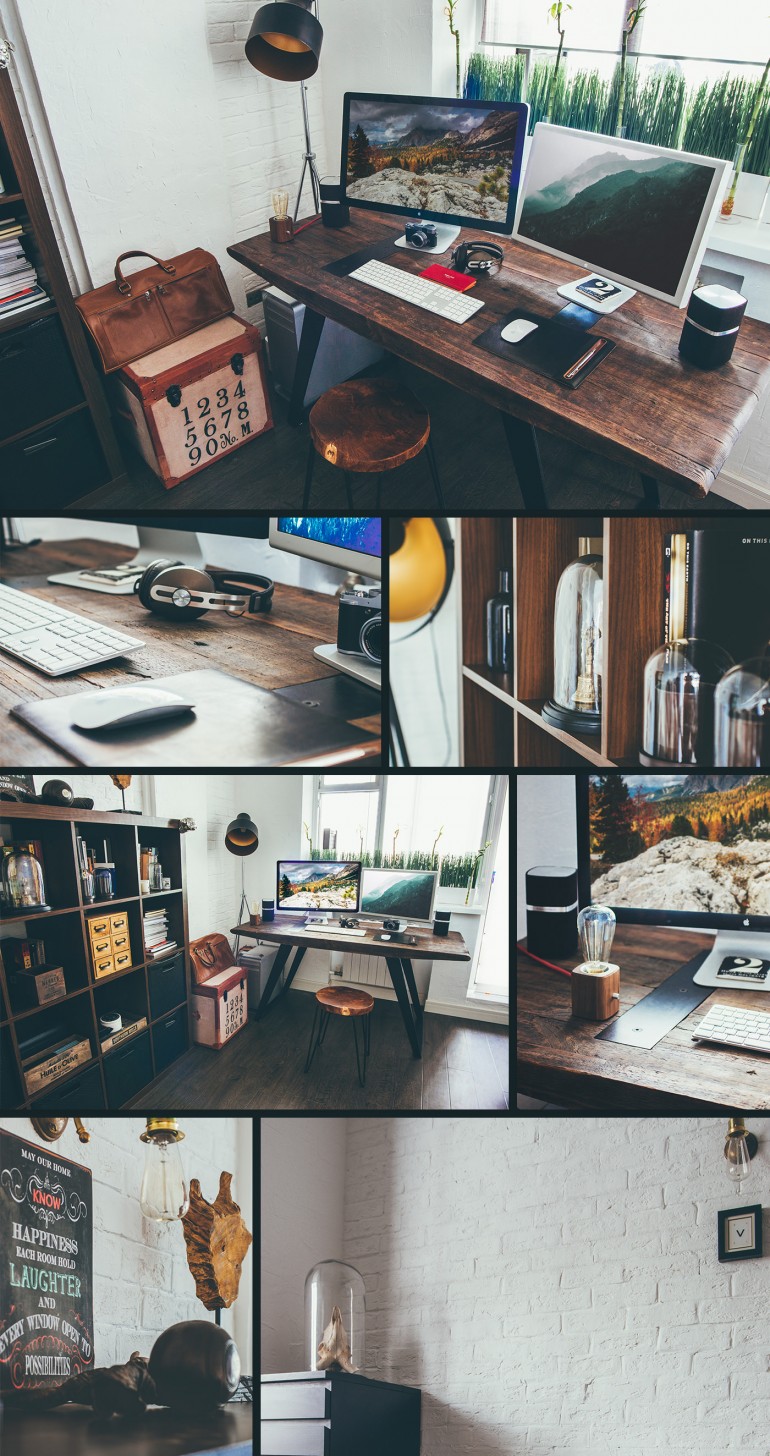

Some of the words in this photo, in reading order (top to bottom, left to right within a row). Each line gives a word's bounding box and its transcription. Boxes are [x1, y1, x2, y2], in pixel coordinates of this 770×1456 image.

[220, 431, 238, 449] No.
[729, 957, 763, 974] 2
[21, 1148, 36, 1162] MAY
[37, 1156, 51, 1169] OUR
[53, 1163, 71, 1177] HOME
[32, 1189, 61, 1210] KNOW
[12, 1222, 79, 1255] HAPPINESS
[16, 1246, 35, 1261] EACH
[37, 1251, 57, 1266] ROOM
[58, 1258, 76, 1270] HOLD
[9, 1262, 82, 1298] LAUGHTER
[38, 1297, 56, 1309] AND
[0, 1319, 24, 1355] EVERY
[26, 1314, 60, 1332] WINDOW
[61, 1320, 81, 1345] OPEN
[81, 1337, 91, 1357] TO
[25, 1355, 71, 1376] POSSIBILITIES
